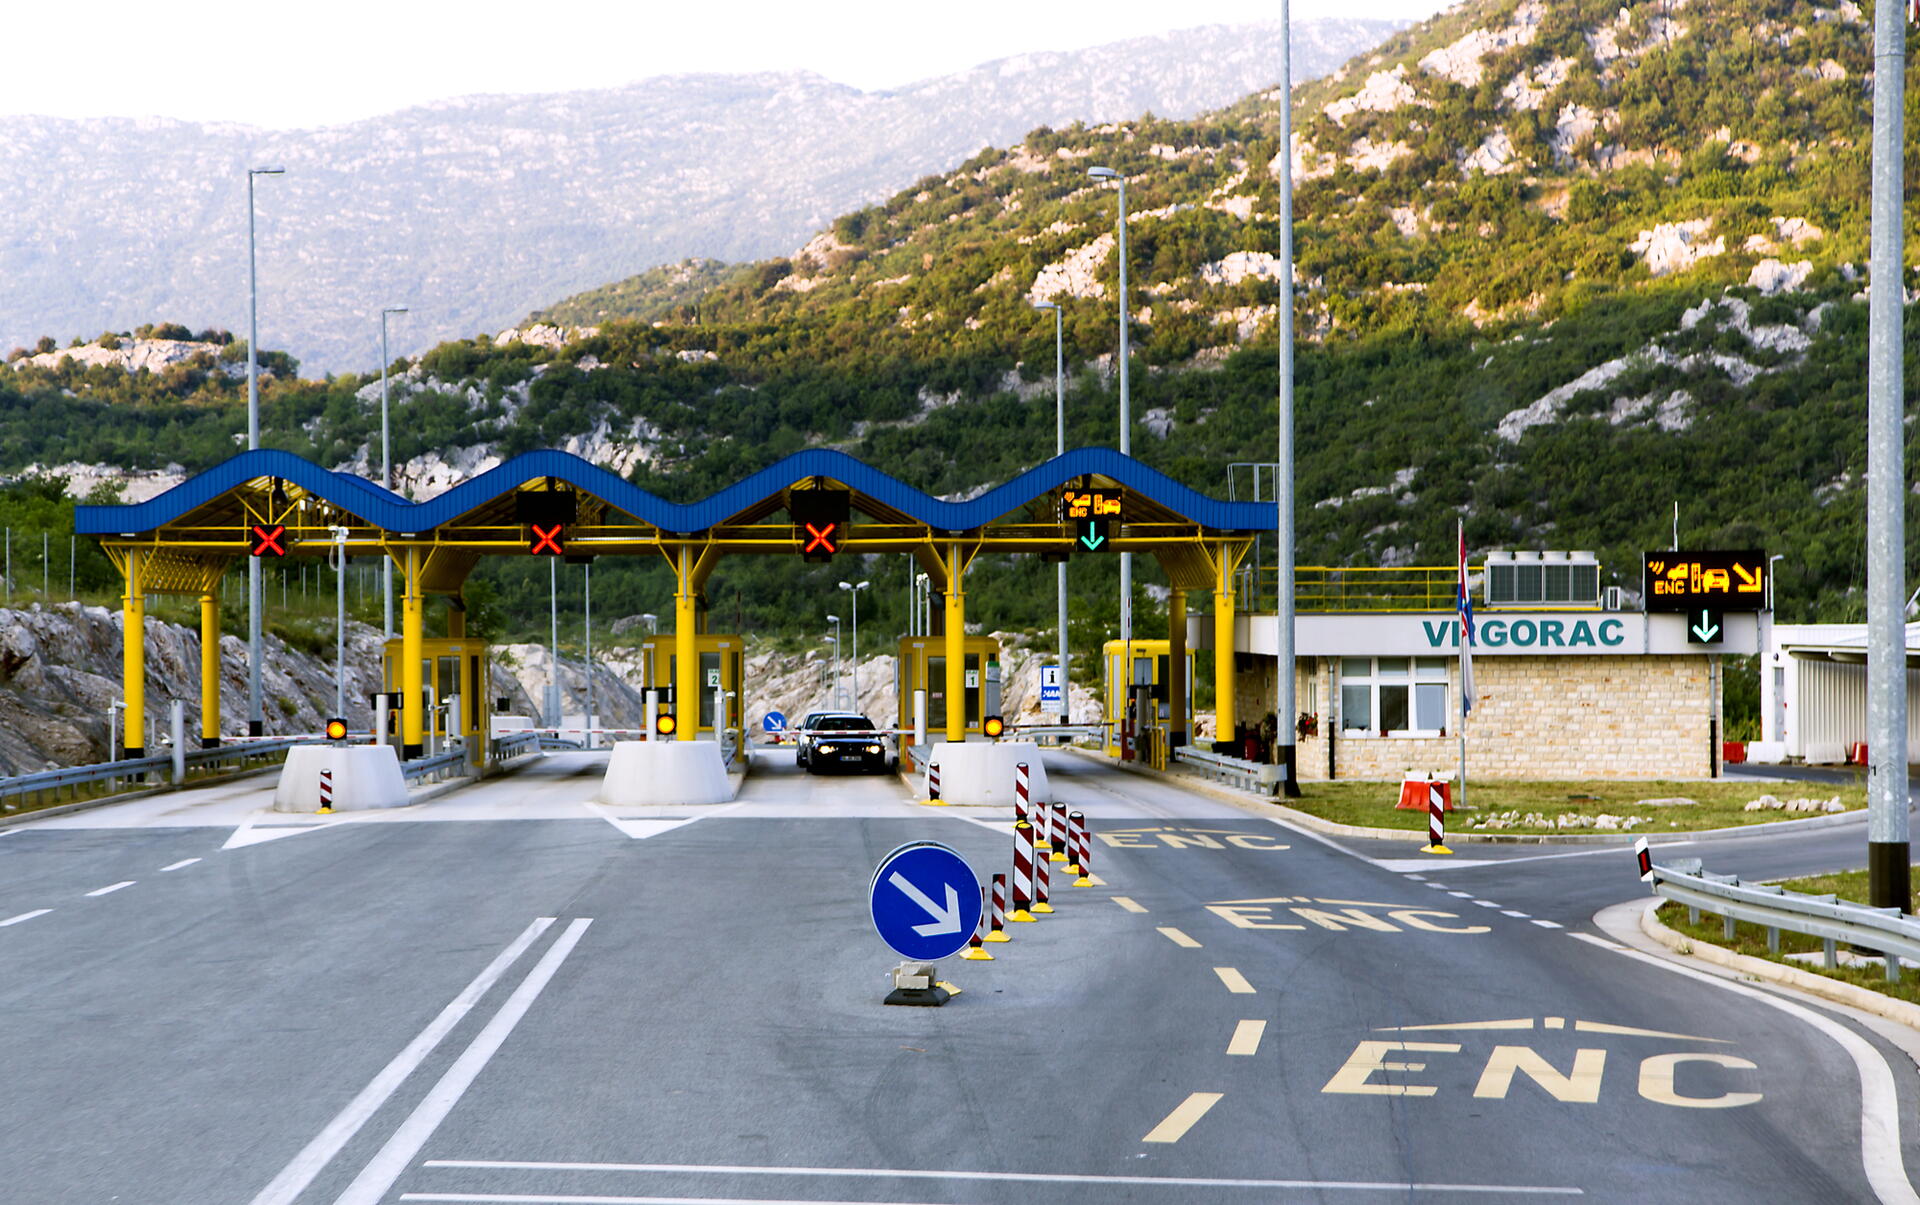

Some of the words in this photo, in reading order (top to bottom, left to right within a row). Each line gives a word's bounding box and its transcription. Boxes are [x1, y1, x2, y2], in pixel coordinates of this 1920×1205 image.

[1655, 580, 1684, 594] ENC
[711, 675, 718, 685] 2
[971, 676, 975, 686] 1
[1095, 833, 1290, 850] ENC
[1204, 905, 1491, 934] ENC
[1321, 1041, 1763, 1108] ENC
